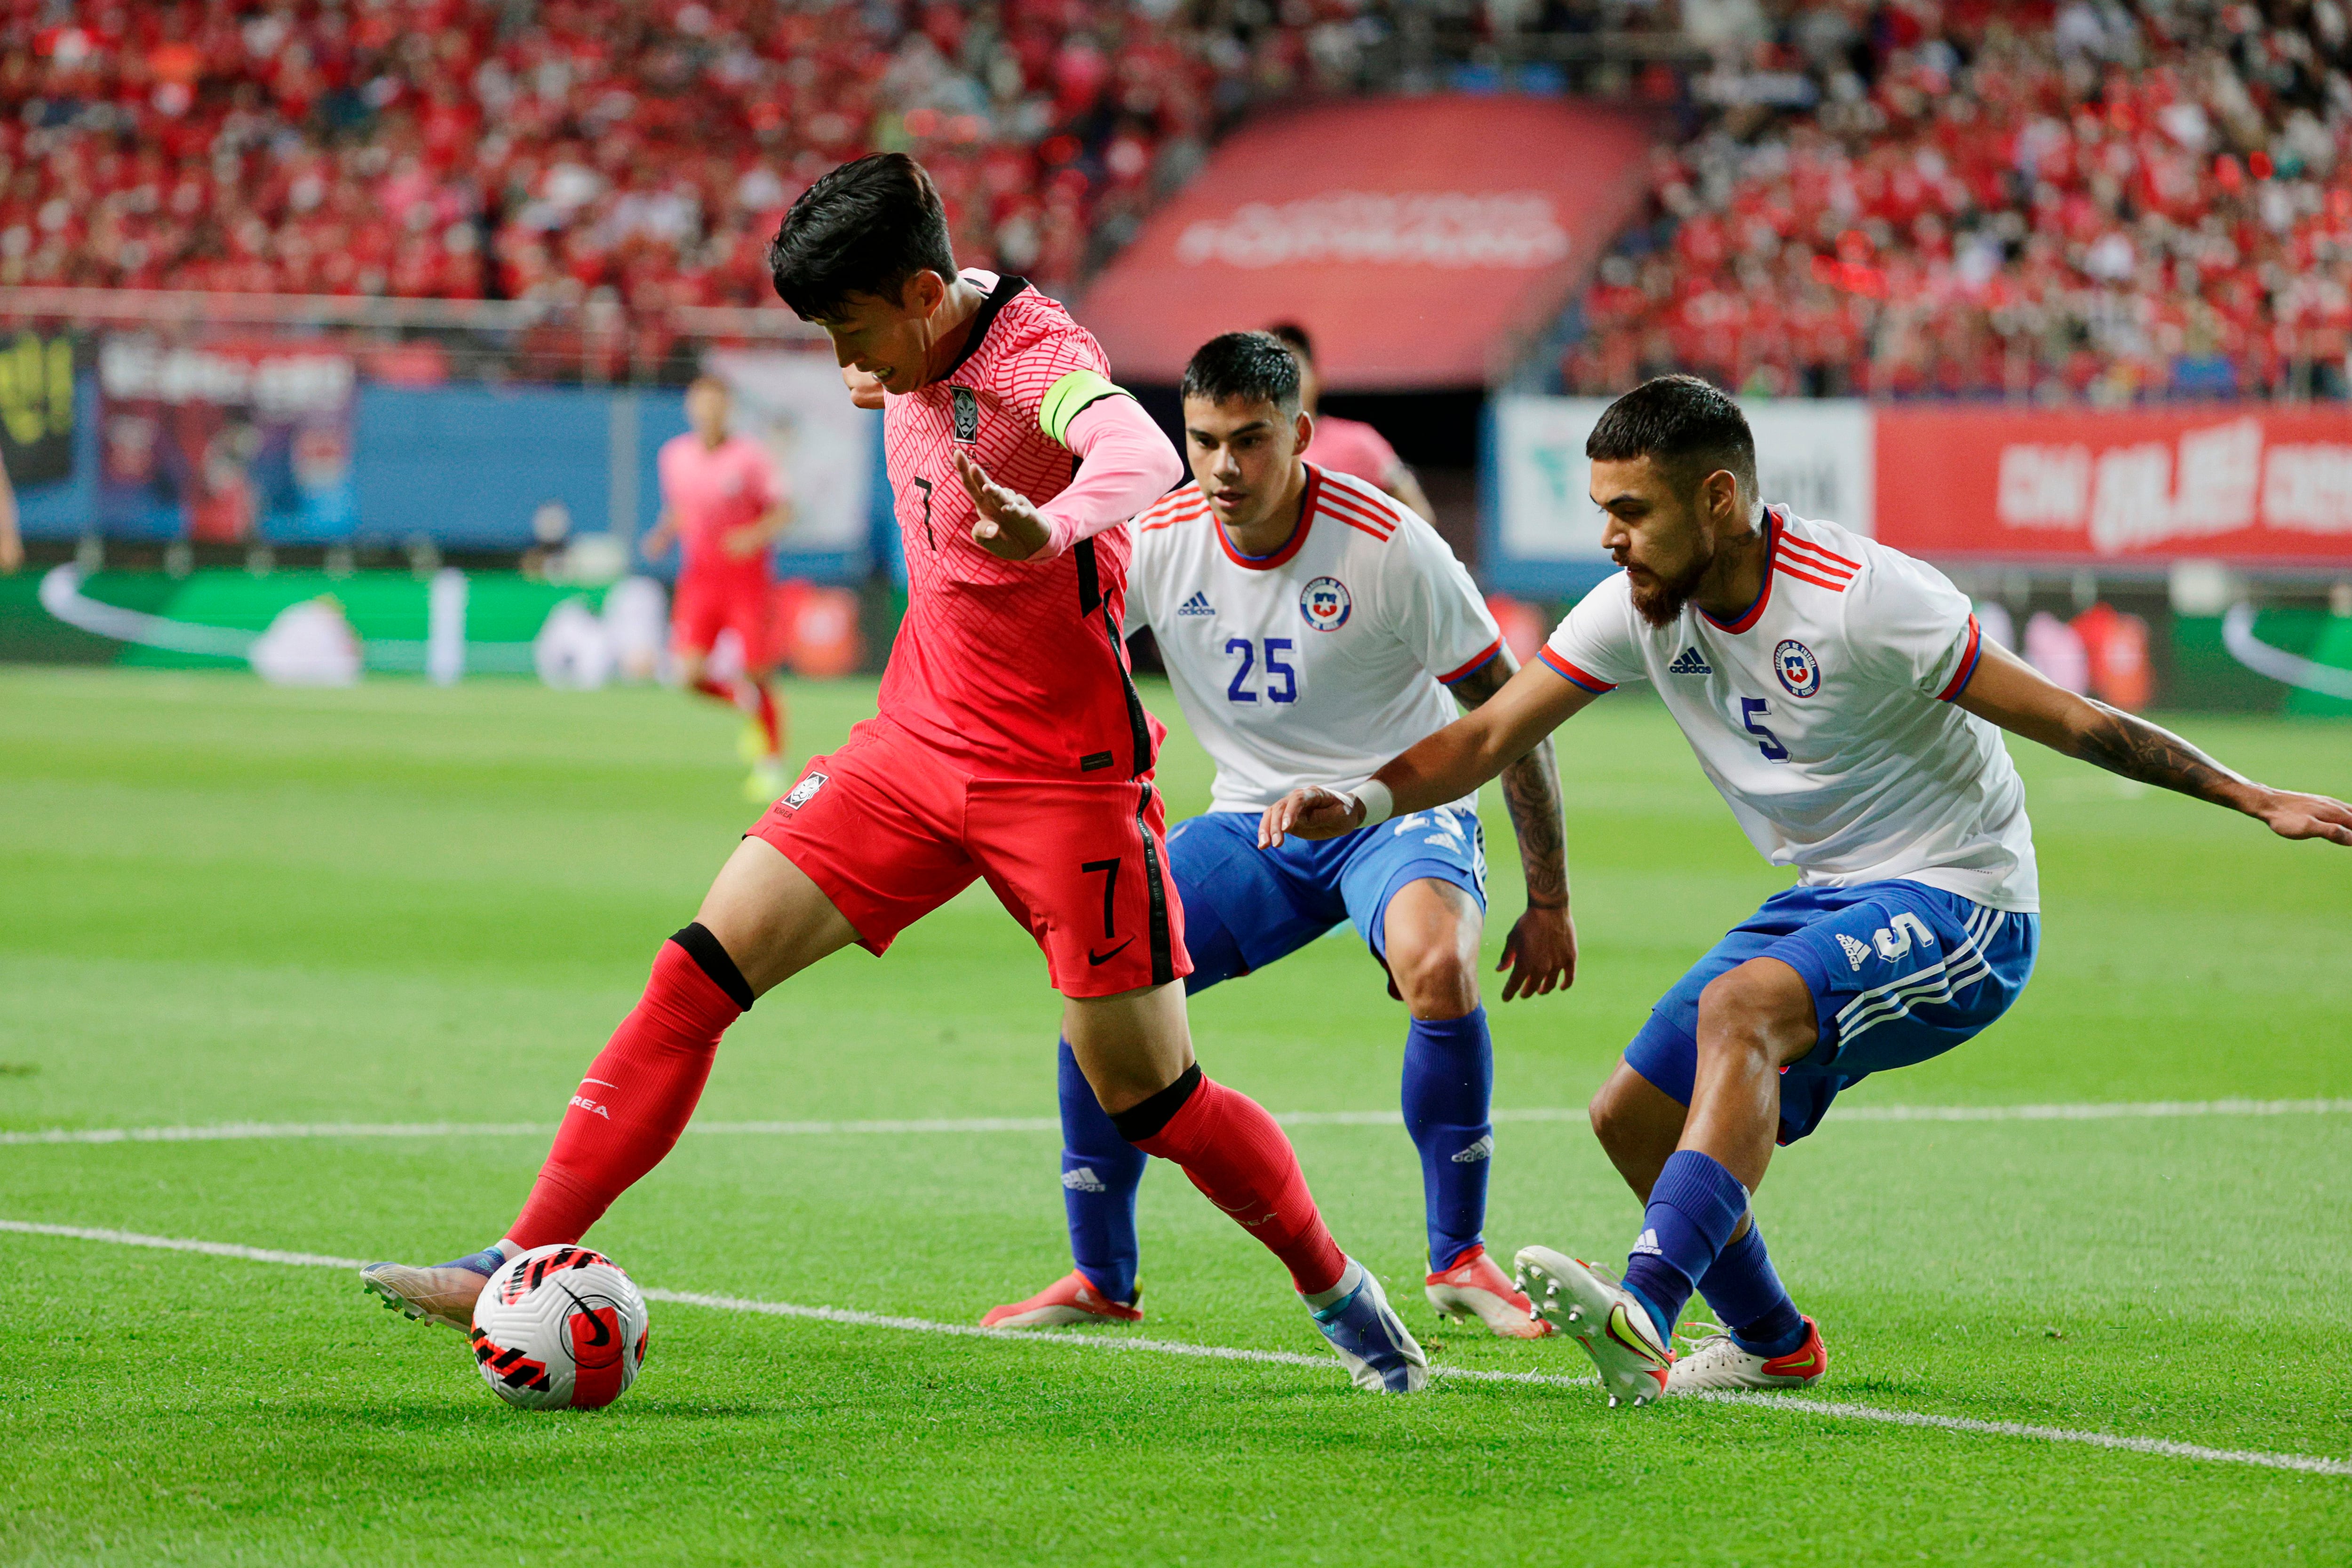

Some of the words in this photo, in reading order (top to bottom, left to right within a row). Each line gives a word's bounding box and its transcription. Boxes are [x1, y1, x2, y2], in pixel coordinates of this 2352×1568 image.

[914, 476, 937, 551] 7
[1178, 607, 1216, 616] adidas
[1226, 639, 1298, 704] 25
[1669, 664, 1712, 674] adidas
[1801, 647, 1816, 668] FUTBOL
[1740, 697, 1793, 764] 5
[773, 807, 793, 820] KOREA
[1081, 857, 1121, 939] 7
[1836, 933, 1860, 972] adidas
[1872, 911, 1934, 963] 5
